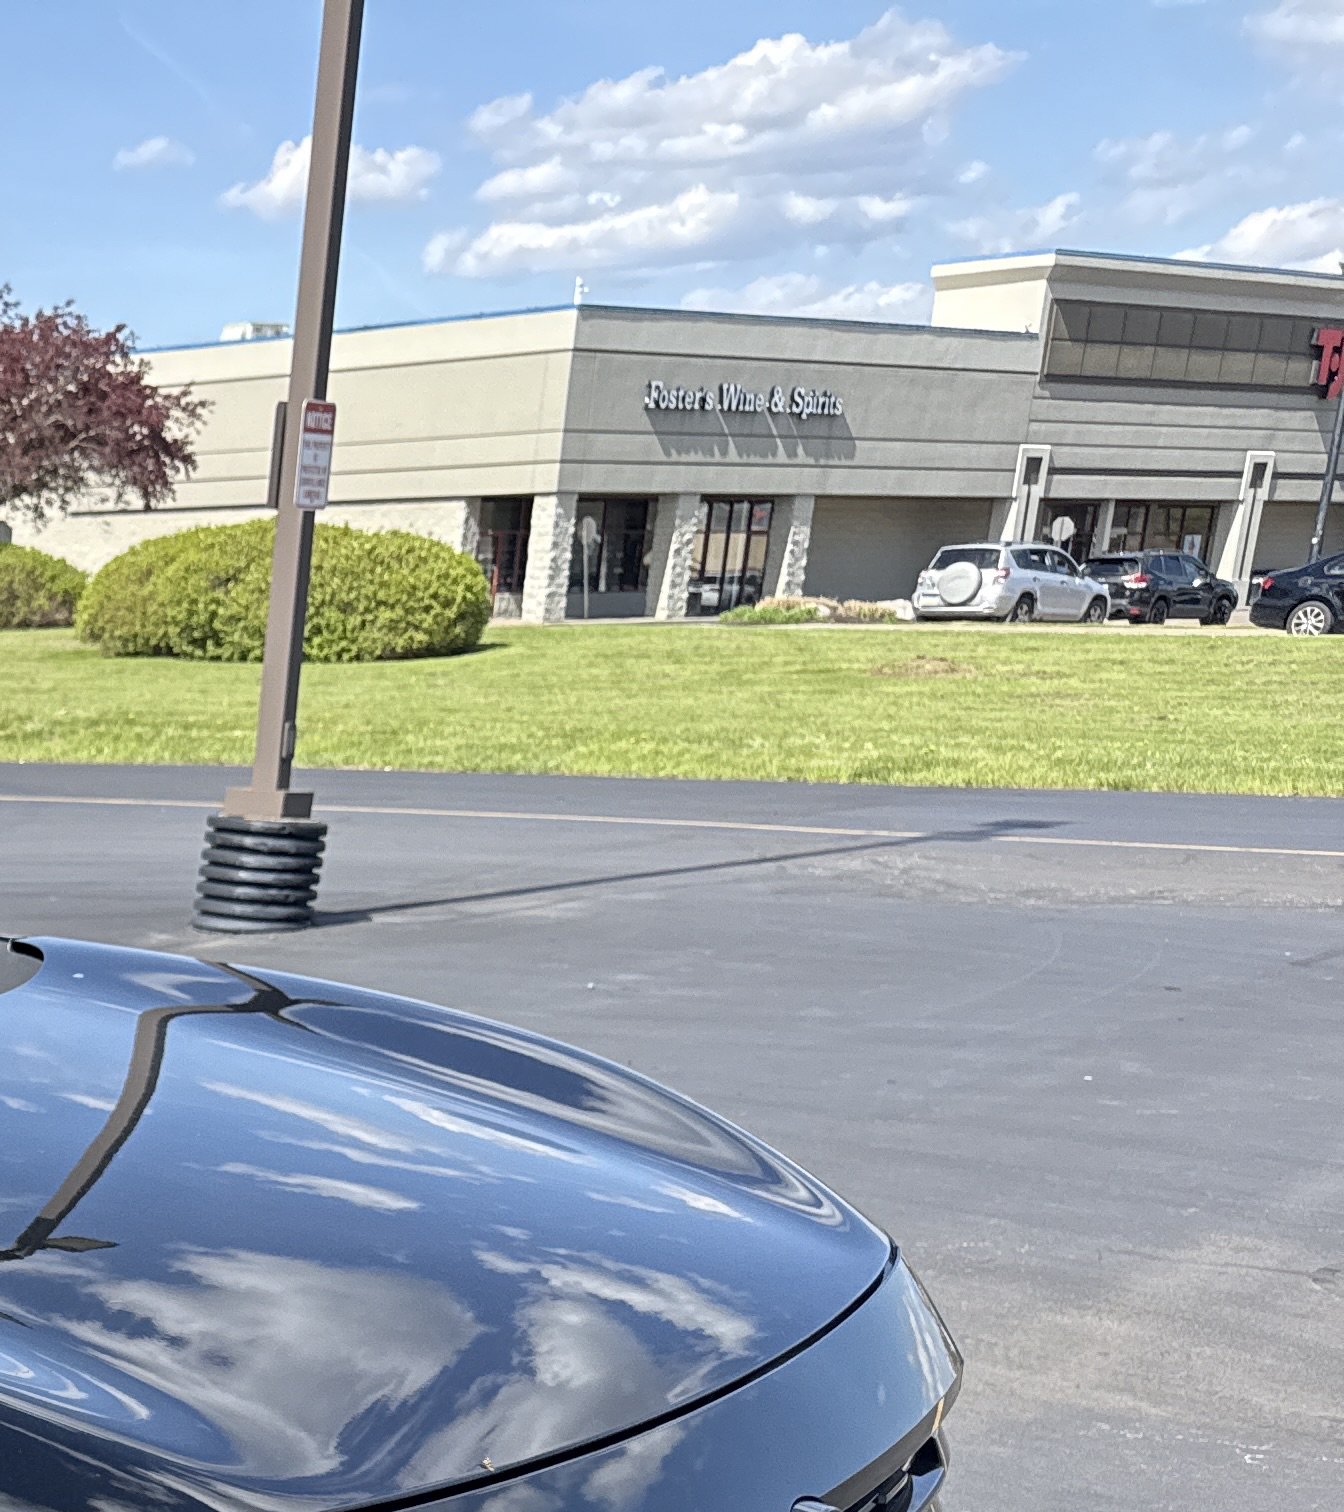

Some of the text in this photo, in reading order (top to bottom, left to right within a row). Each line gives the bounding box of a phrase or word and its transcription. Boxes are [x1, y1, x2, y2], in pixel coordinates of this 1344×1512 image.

[646, 380, 844, 419] Foster's Wine & Spirits
